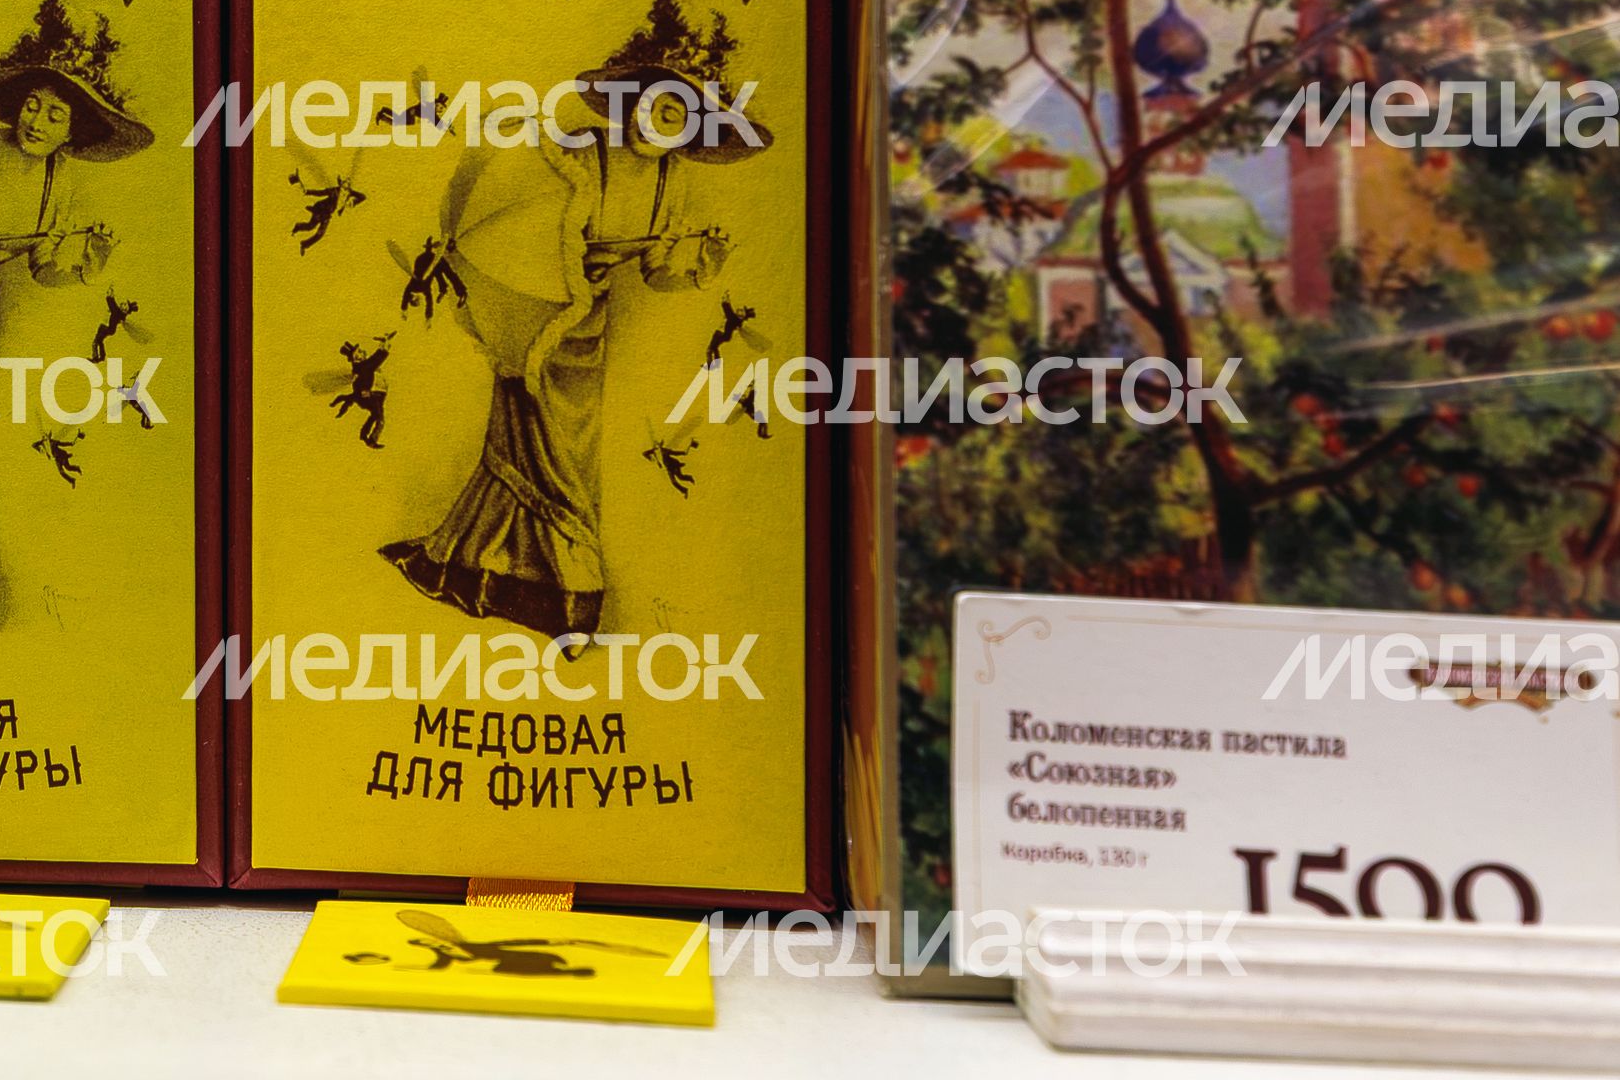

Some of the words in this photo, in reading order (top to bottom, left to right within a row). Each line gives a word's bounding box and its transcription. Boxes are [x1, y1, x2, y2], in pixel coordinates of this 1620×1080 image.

[413, 704, 627, 759] МЕДОВАЯ
[1007, 709, 1213, 752] Коломенская
[1222, 729, 1347, 758] пастила
[366, 751, 464, 802] ДЛЯ
[487, 760, 694, 811] ФИГУРЫ
[1007, 751, 1177, 790] «Союзная»
[1006, 792, 1187, 832] белопенная
[1232, 843, 1543, 927] 1500
